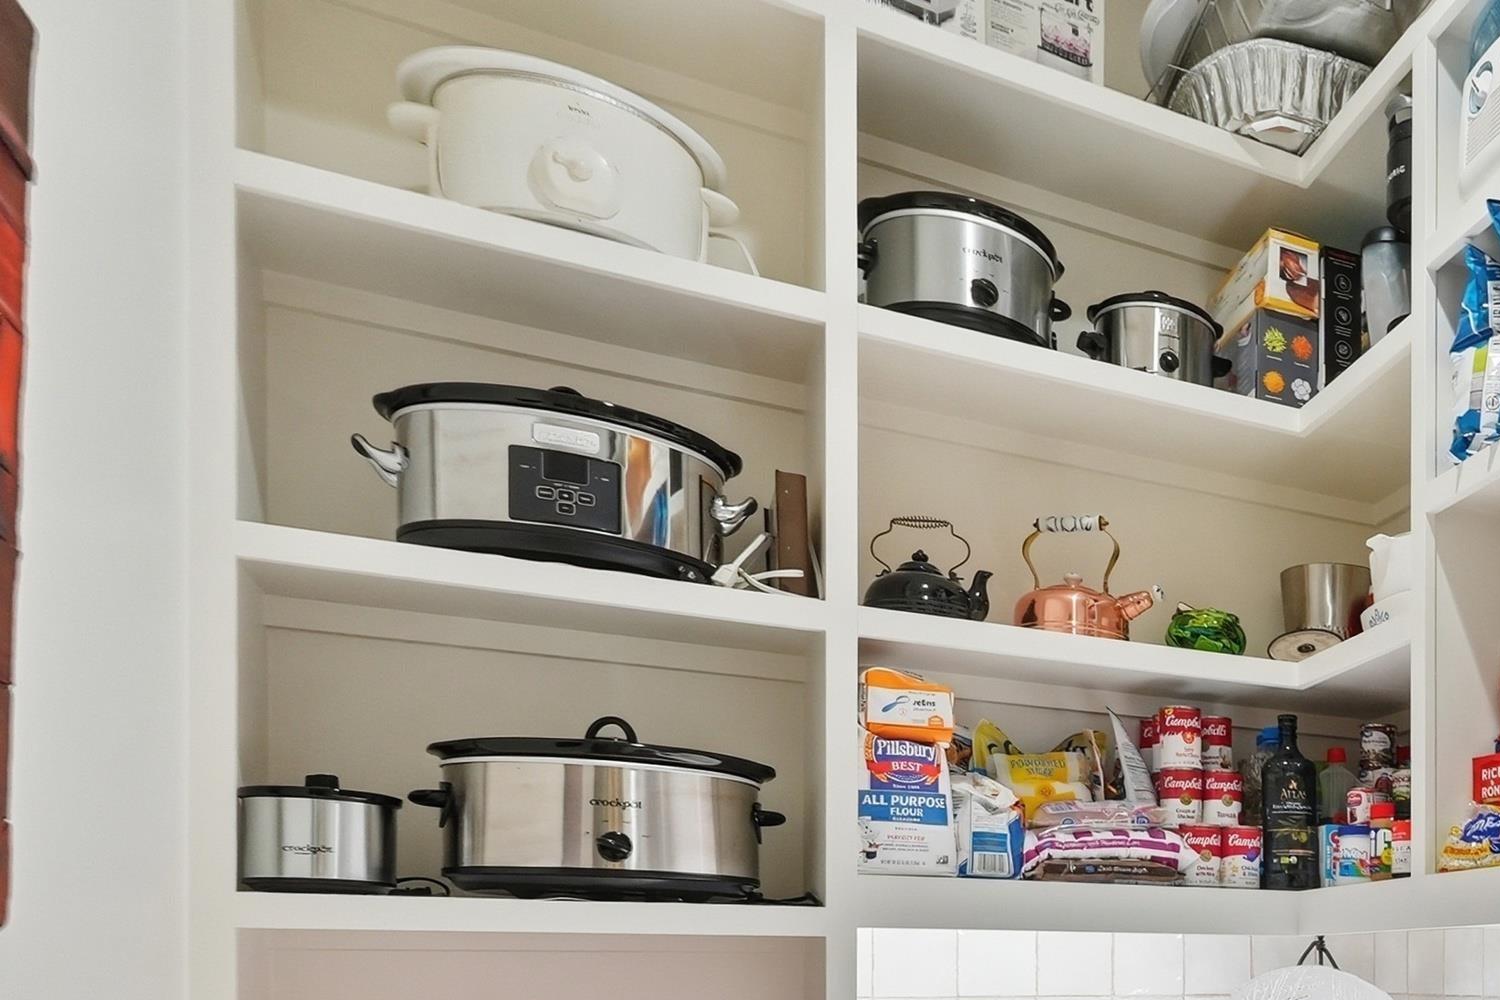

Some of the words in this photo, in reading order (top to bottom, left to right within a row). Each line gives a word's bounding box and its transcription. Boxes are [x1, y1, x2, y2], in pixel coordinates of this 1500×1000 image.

[1165, 714, 1200, 729] Campbe
[876, 739, 936, 762] Pillsbury
[892, 762, 923, 772] BEST
[863, 795, 888, 806] ALL
[893, 795, 945, 808] PURPOSE
[890, 806, 923, 817] FLOUR
